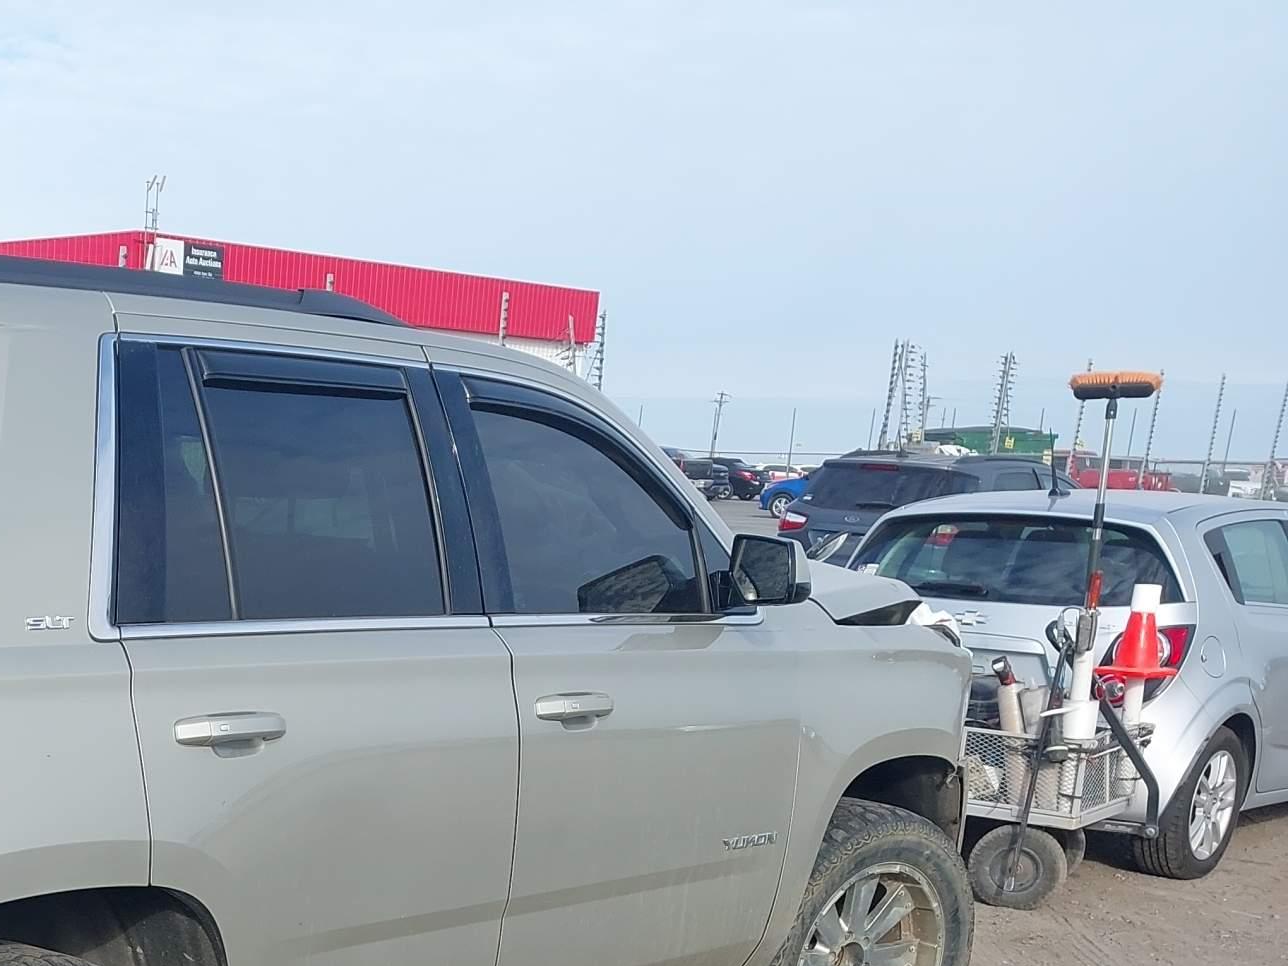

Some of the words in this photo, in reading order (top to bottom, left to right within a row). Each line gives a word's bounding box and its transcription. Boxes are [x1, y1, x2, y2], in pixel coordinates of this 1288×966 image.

[185, 256, 198, 265] Auto
[199, 257, 222, 269] Auctions
[26, 616, 75, 631] SLT
[722, 831, 779, 851] YUKON
